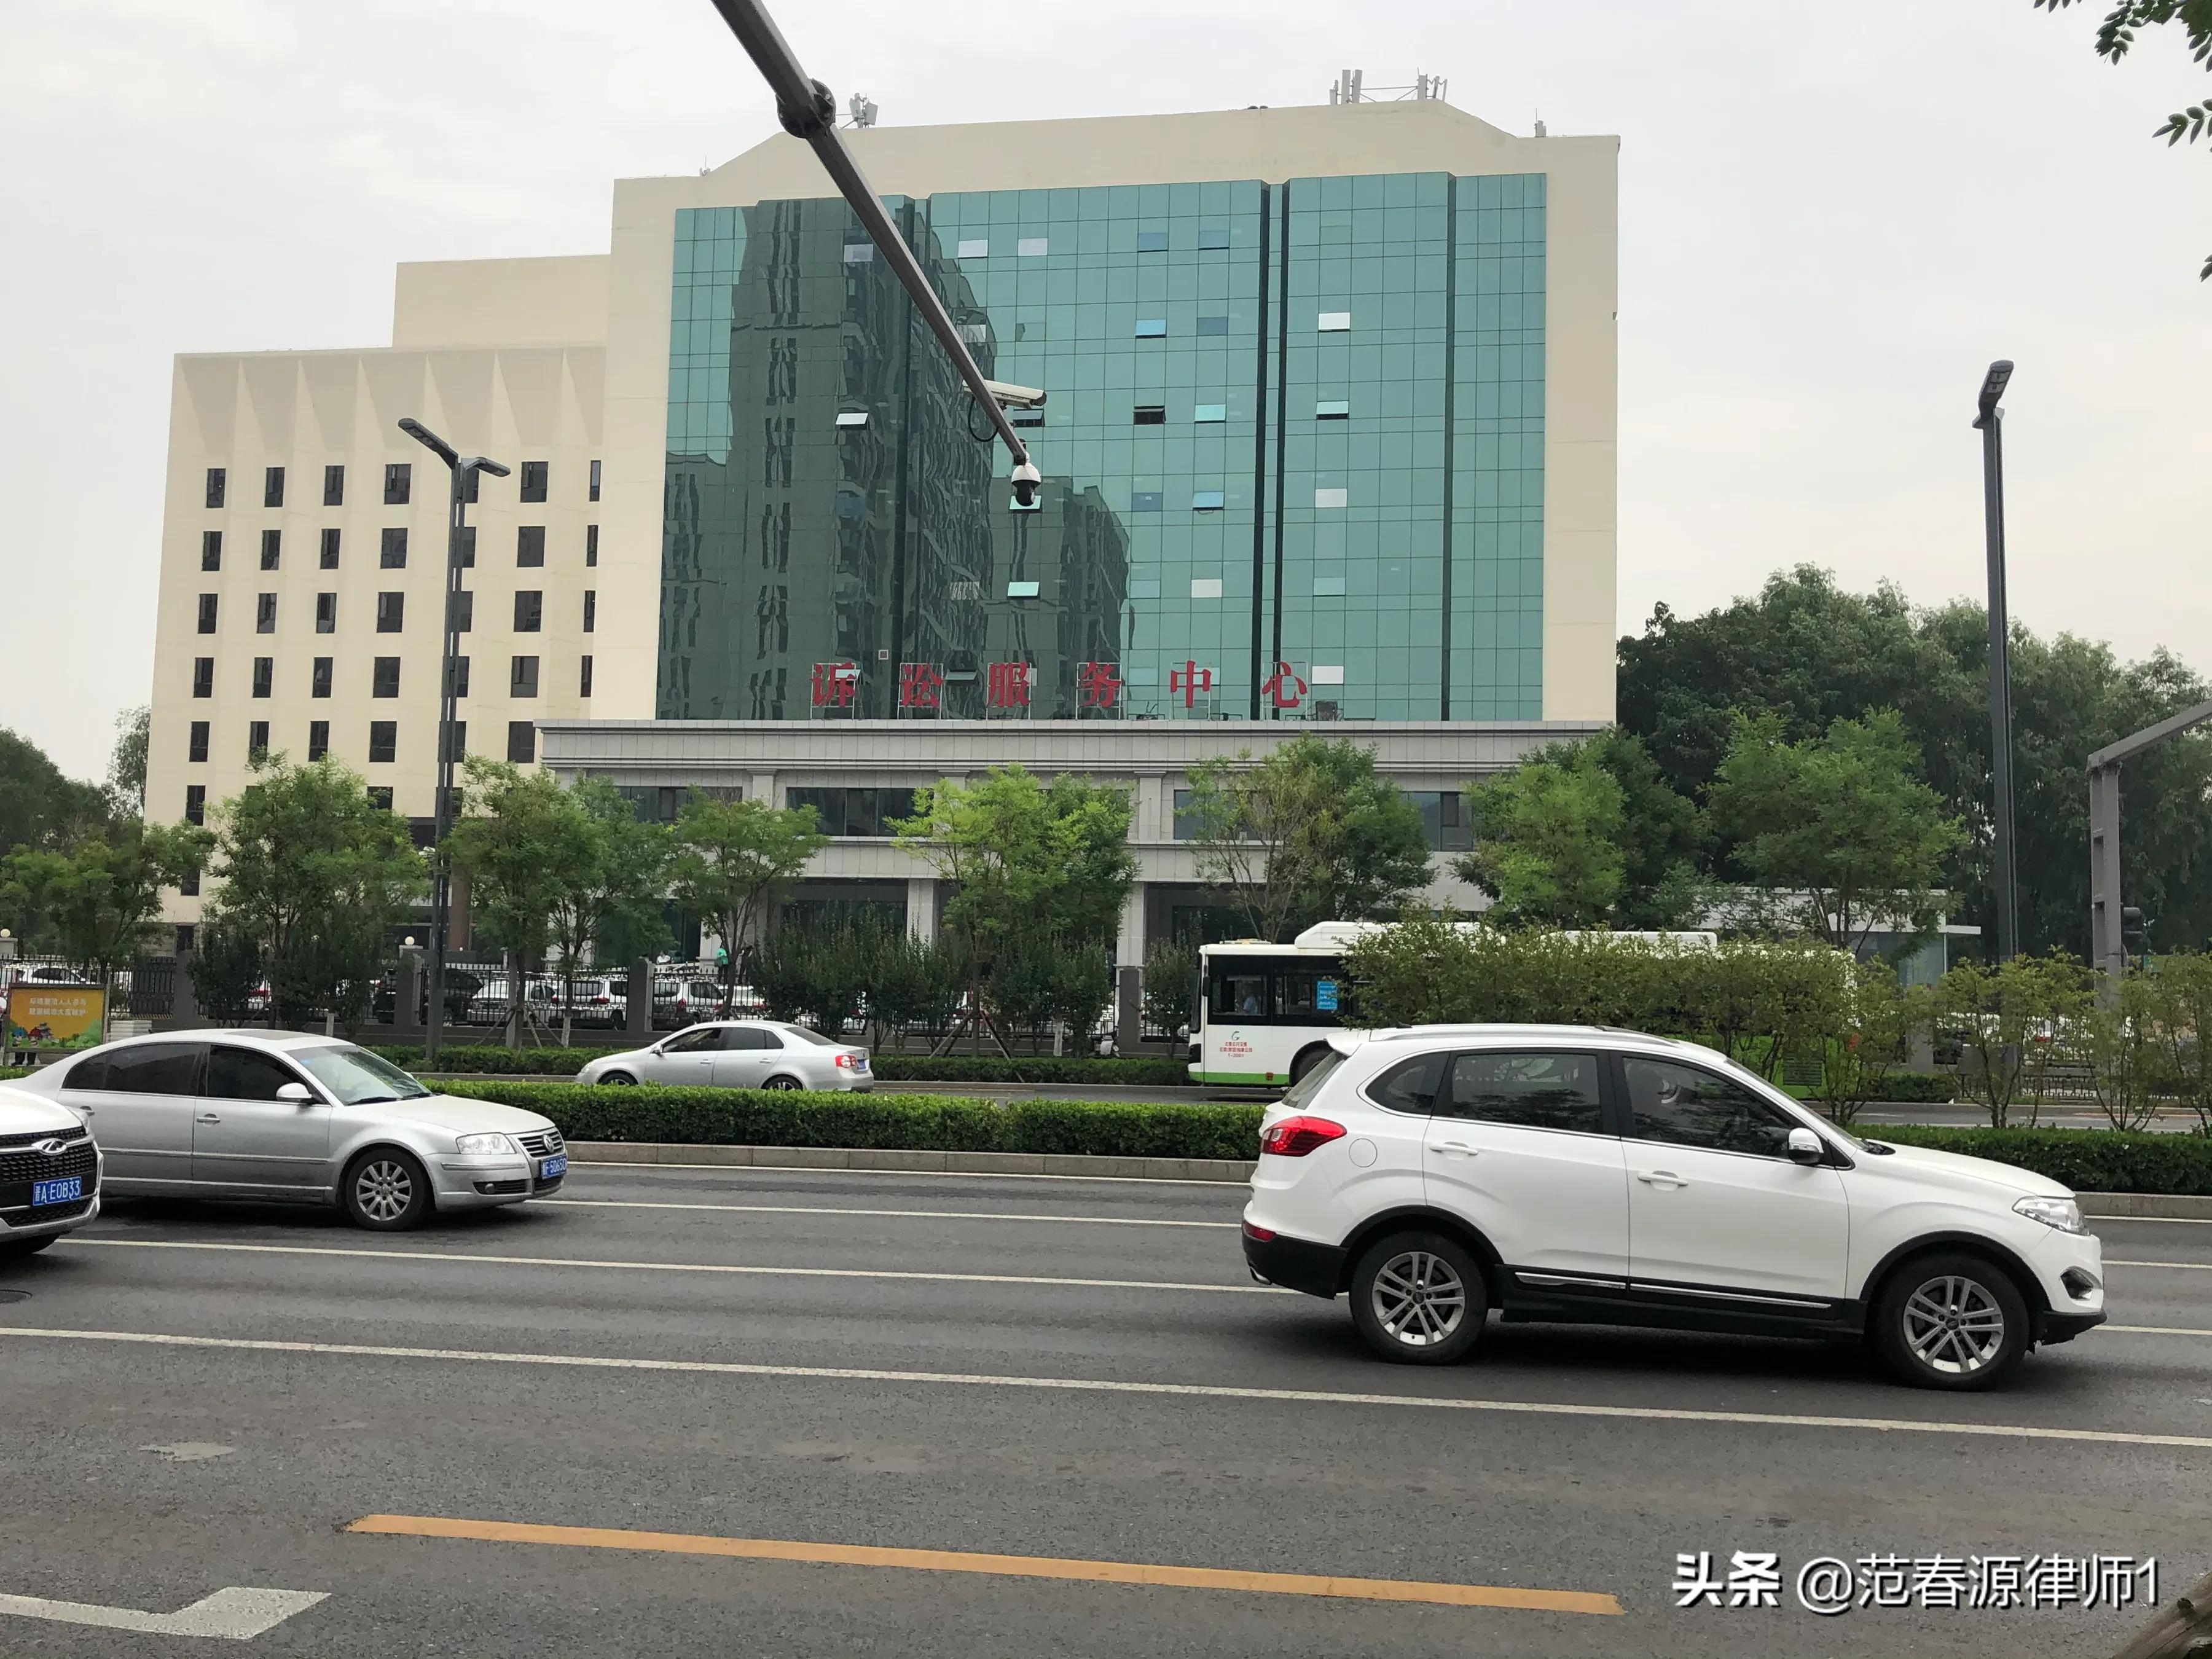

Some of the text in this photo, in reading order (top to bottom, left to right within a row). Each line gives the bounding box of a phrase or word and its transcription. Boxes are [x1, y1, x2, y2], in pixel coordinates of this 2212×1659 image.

[810, 660, 1308, 708] 诉讼服务中心
